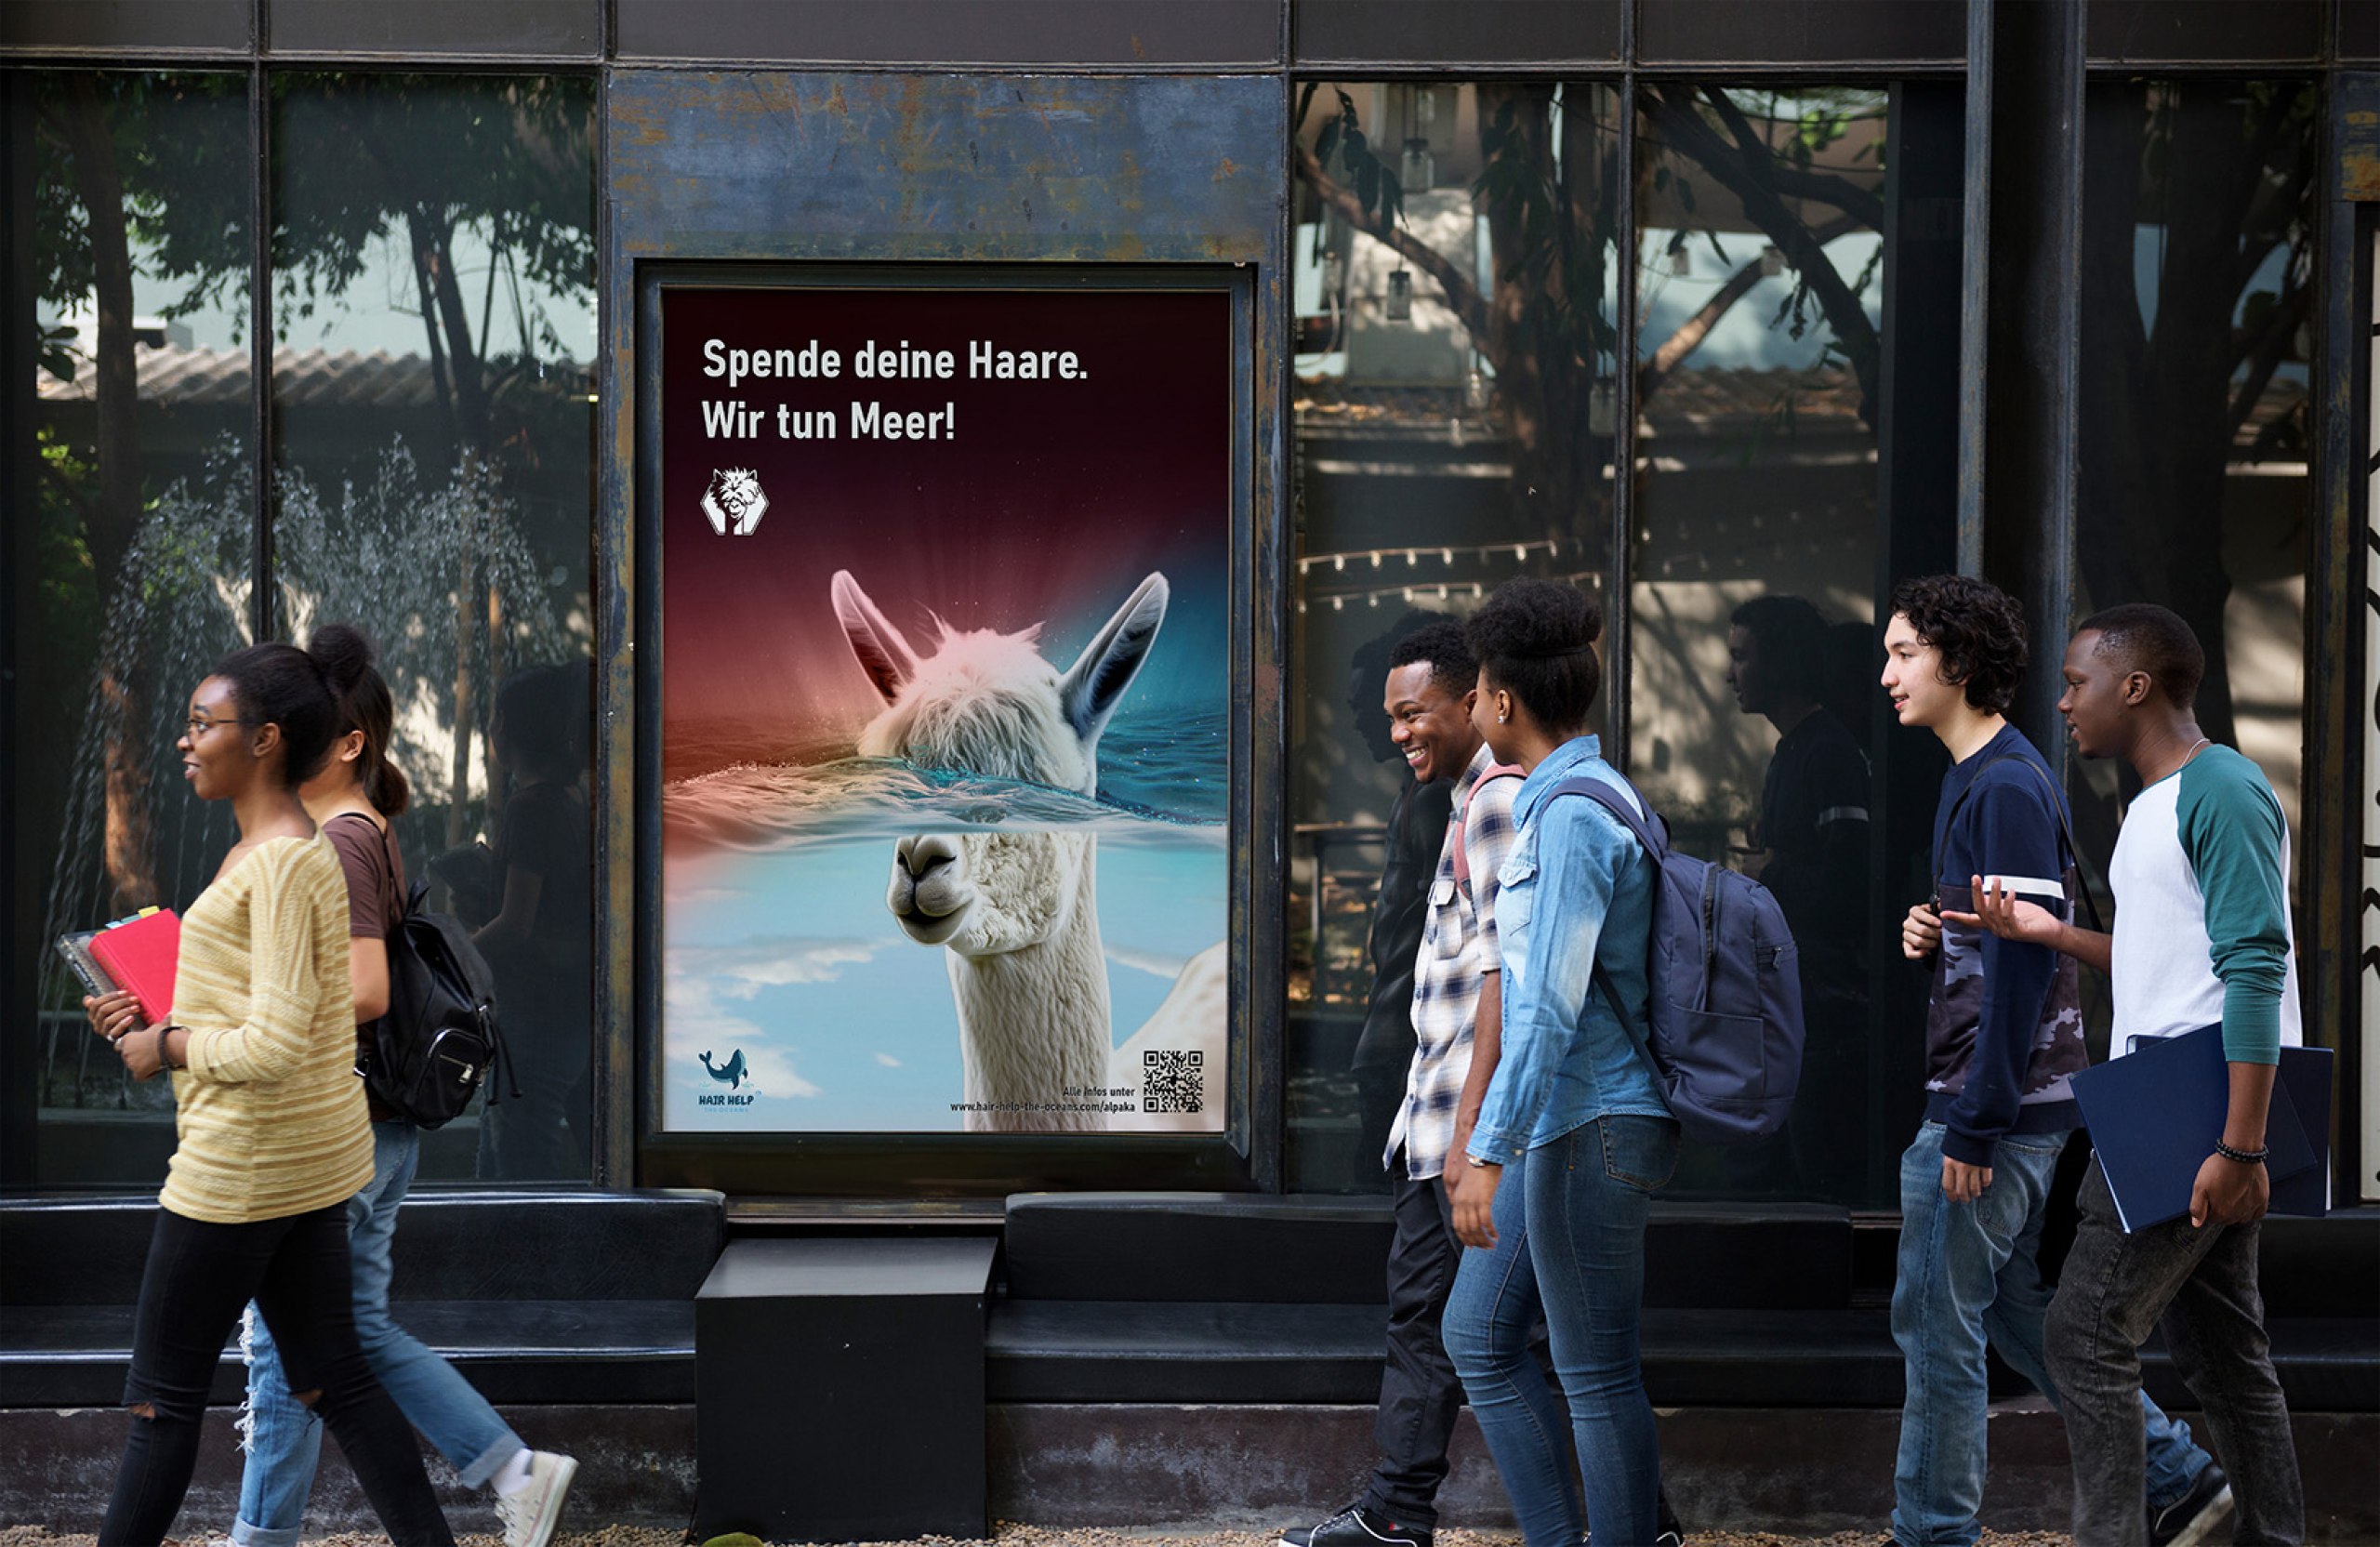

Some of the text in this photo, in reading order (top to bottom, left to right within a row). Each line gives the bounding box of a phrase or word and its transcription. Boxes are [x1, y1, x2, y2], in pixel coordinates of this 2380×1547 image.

[704, 339, 1088, 387] Spende deine Haare.
[702, 402, 955, 439] Wir tun Meer!
[698, 1095, 755, 1105] HAIR HELP
[1063, 1086, 1081, 1097] Alle
[1110, 1086, 1135, 1097] unter
